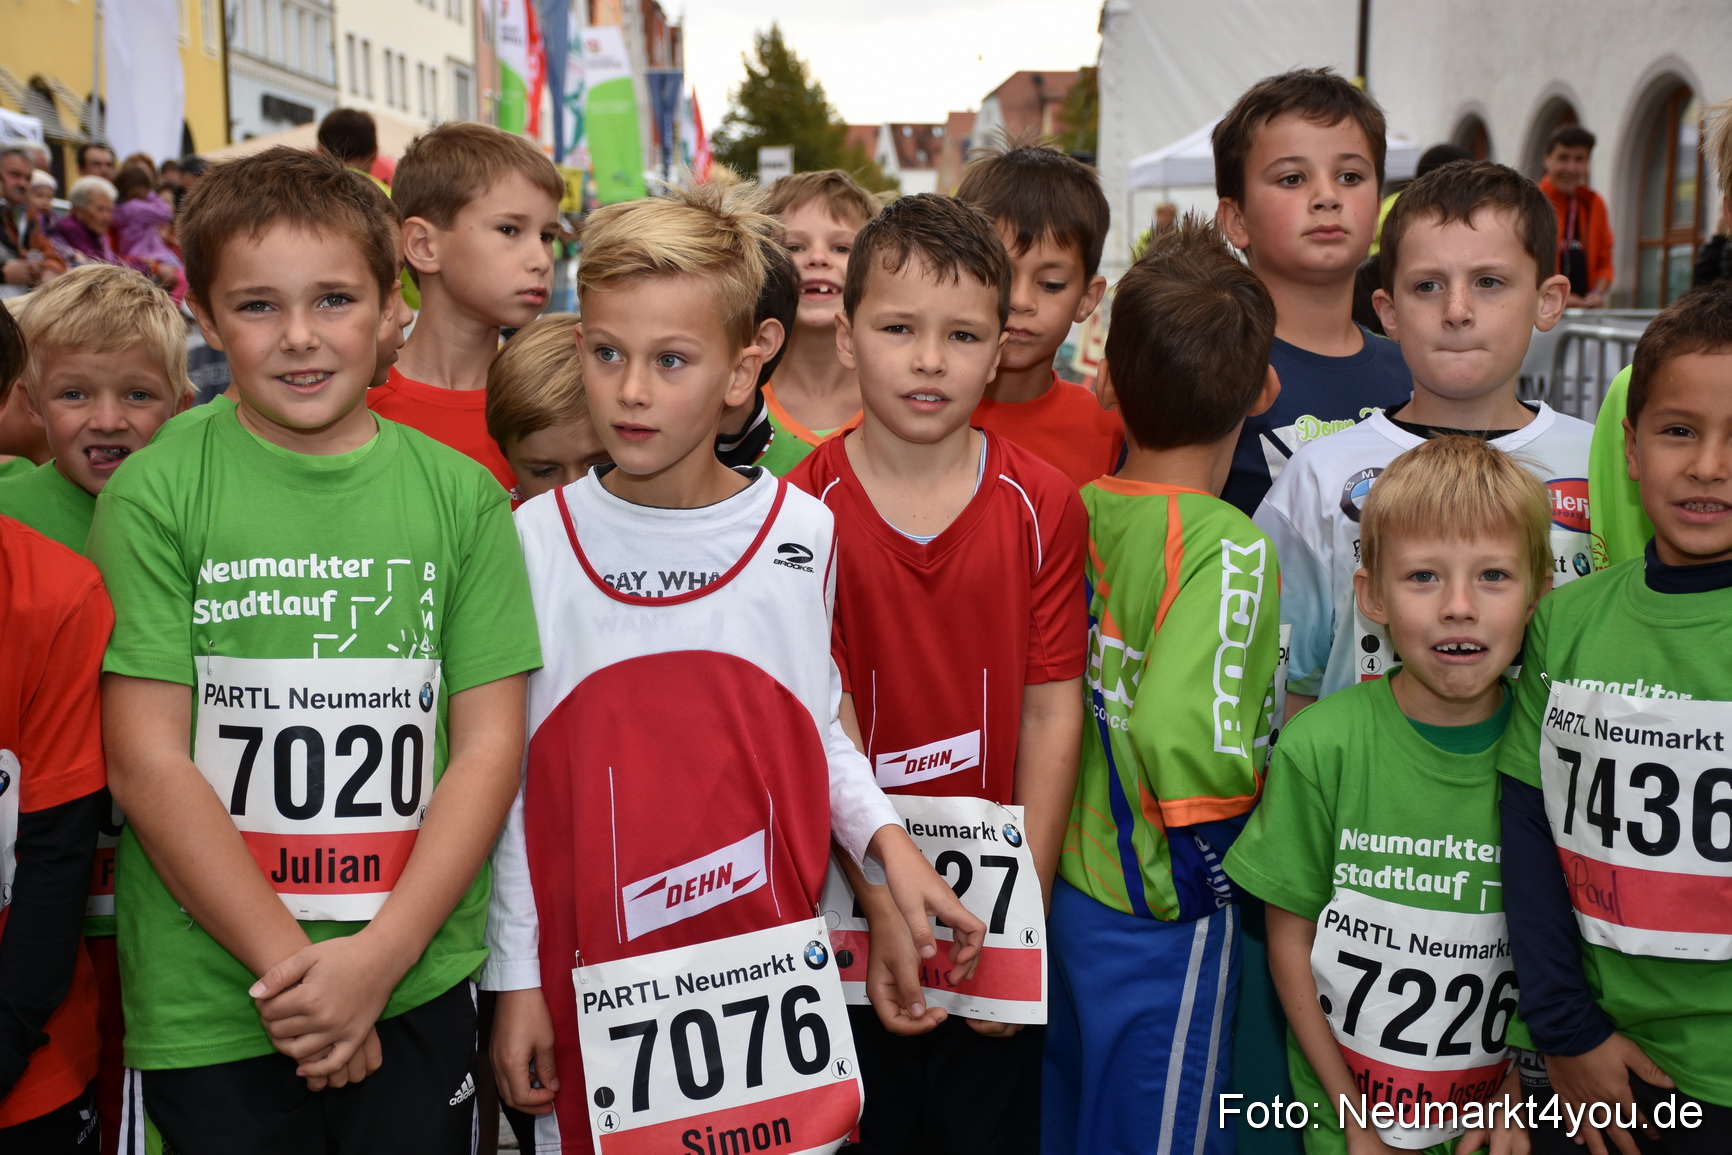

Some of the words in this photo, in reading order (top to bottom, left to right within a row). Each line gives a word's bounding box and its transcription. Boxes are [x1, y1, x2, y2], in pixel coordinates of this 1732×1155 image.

[197, 553, 374, 585] Neumarkter
[603, 570, 648, 590] SAY
[658, 570, 721, 591] WHA
[192, 589, 338, 625] Stadtlauf
[204, 683, 280, 710] PARTL
[289, 686, 411, 710] Neumarkt
[1546, 707, 1590, 738] PARTL
[1595, 717, 1724, 752] Neumarkt
[219, 724, 424, 821] 7020
[905, 749, 952, 775] DEHN
[1557, 746, 1732, 863] 7436
[905, 818, 998, 842] eumarkt
[1339, 828, 1502, 863] Neumarkter
[271, 848, 380, 884] Julian
[1333, 863, 1470, 901] Stadtlauf
[666, 862, 733, 910] DEHN
[1569, 855, 1625, 927] Paul
[1324, 909, 1401, 951] PARTL
[1409, 933, 1512, 960] Neumarkt
[583, 980, 670, 1014] PARTL
[675, 953, 796, 996] Neumarkt
[1337, 950, 1520, 1057] 7226
[608, 984, 831, 1113] 7076
[681, 1116, 792, 1155] Simon
